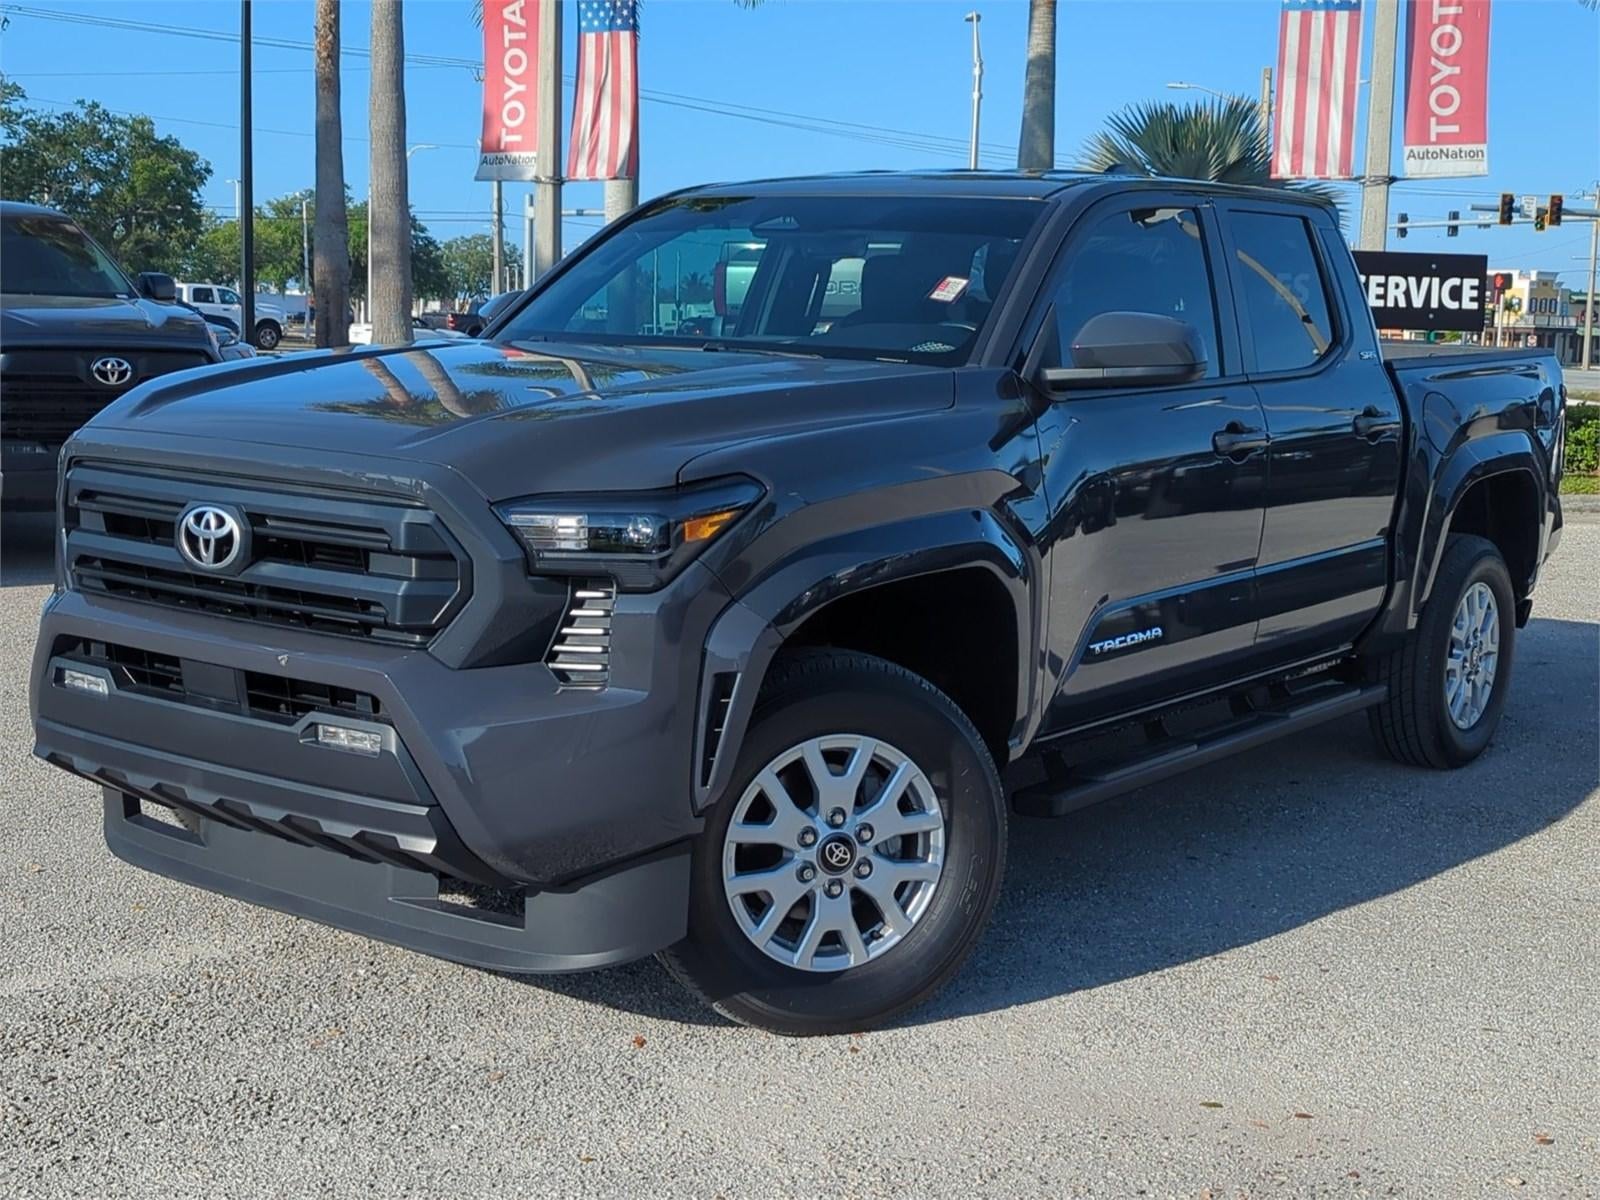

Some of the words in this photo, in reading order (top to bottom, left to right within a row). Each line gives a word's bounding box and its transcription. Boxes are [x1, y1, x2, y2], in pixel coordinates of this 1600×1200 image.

[501, 0, 528, 149] TOYOTA
[1429, 0, 1463, 142] TOYOT
[481, 154, 537, 166] AutoNation
[1406, 148, 1485, 161] AutoNation
[1359, 274, 1480, 310] ERVICE
[1089, 627, 1163, 655] TACOMA
